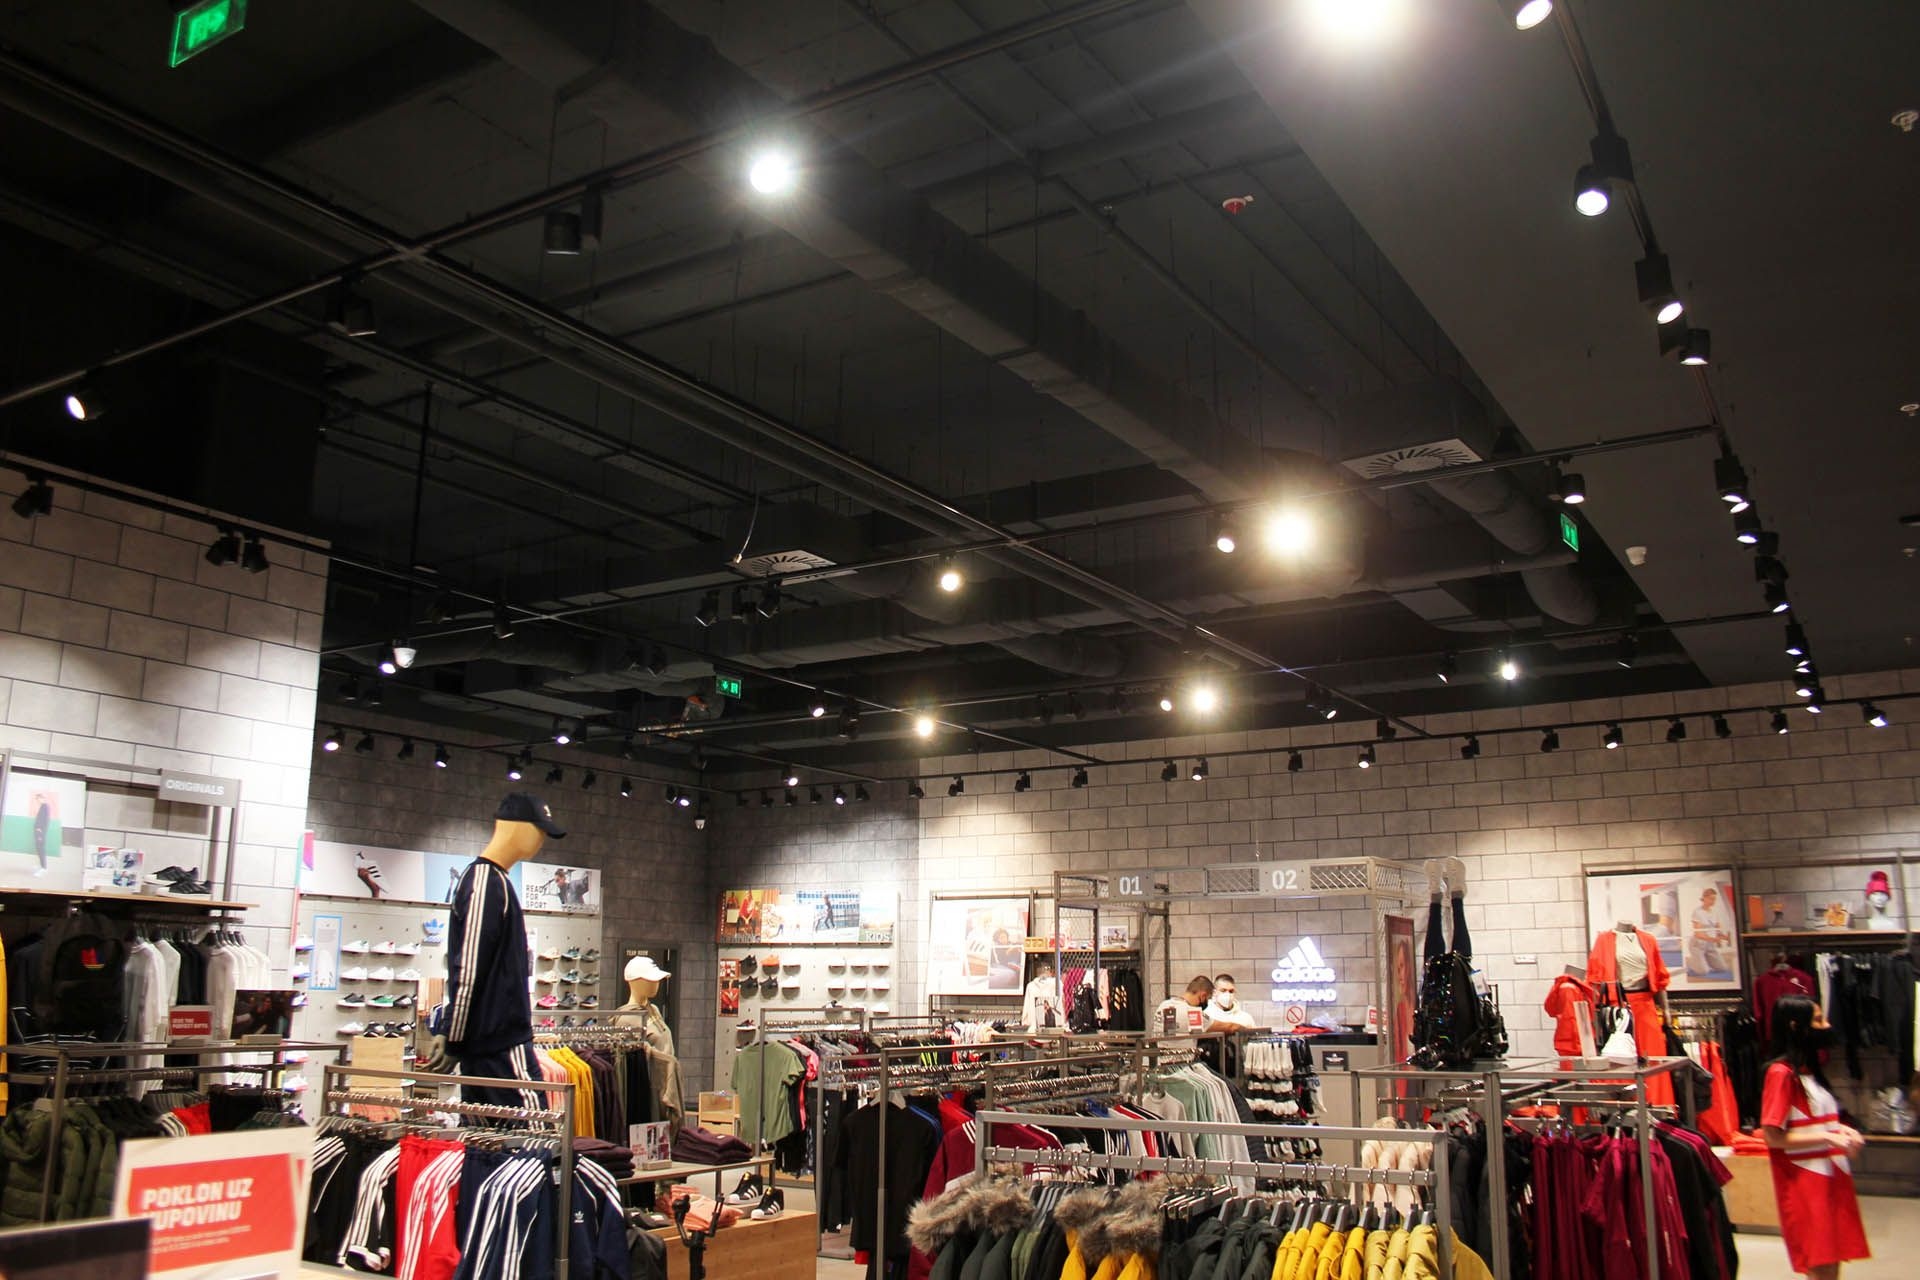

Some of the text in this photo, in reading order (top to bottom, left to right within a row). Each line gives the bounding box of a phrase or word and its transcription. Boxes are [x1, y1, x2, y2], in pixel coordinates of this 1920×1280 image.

[165, 780, 225, 795] ORIGINALS
[1119, 876, 1142, 895] 01
[1272, 869, 1298, 890] 02
[526, 901, 547, 909] SPORT
[1271, 966, 1337, 983] adidas
[1271, 988, 1337, 1002] BEOGRAD
[141, 1178, 254, 1210] POKLON UZ
[141, 1201, 242, 1231] UPOVINU
